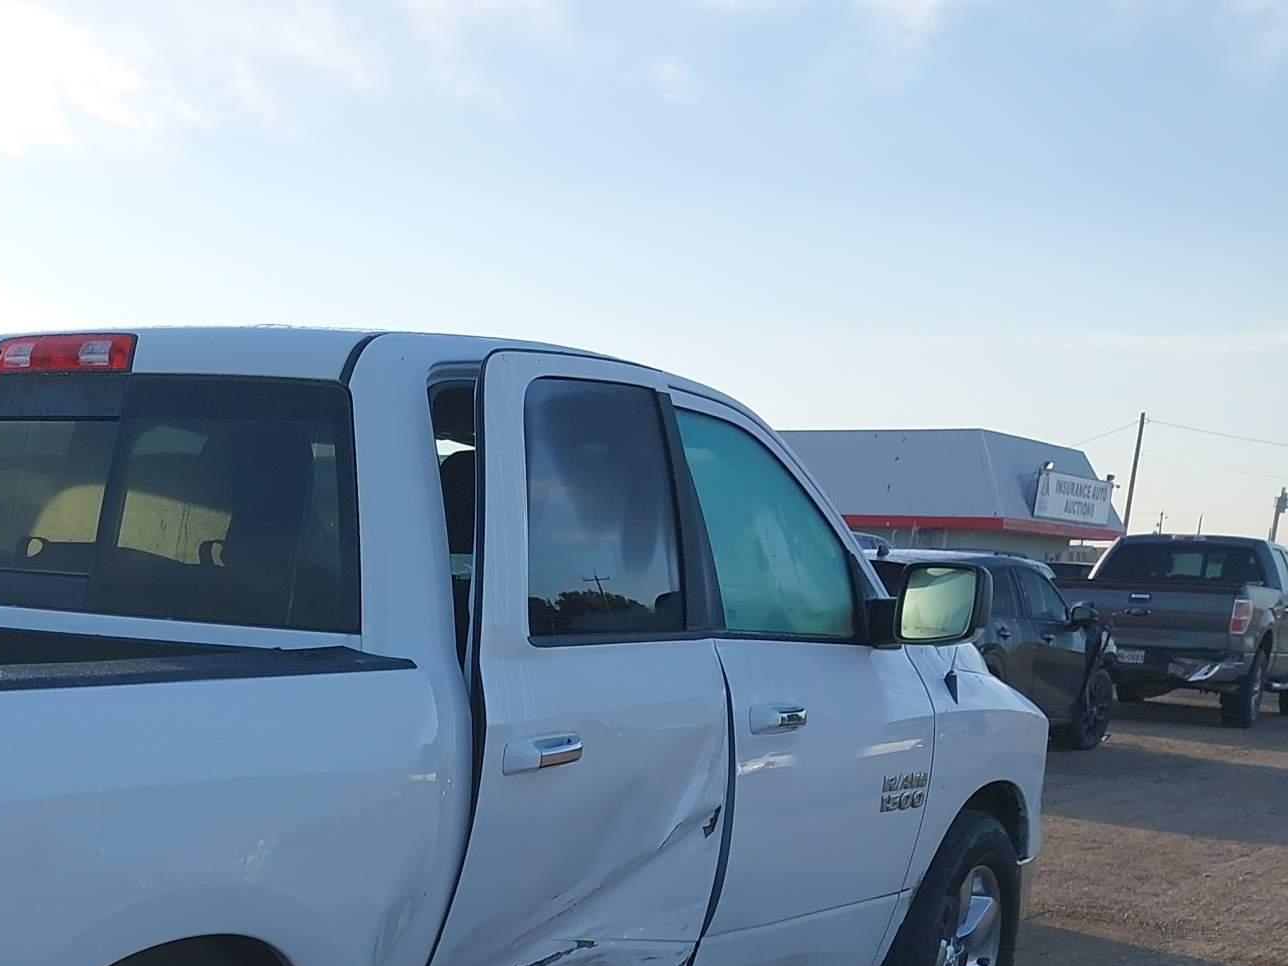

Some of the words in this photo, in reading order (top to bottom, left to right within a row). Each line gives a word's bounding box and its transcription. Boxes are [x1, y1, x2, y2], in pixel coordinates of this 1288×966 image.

[1054, 479, 1092, 499] INSURANCE
[1092, 485, 1108, 503] AUTO
[1063, 498, 1096, 518] AUCTIONS
